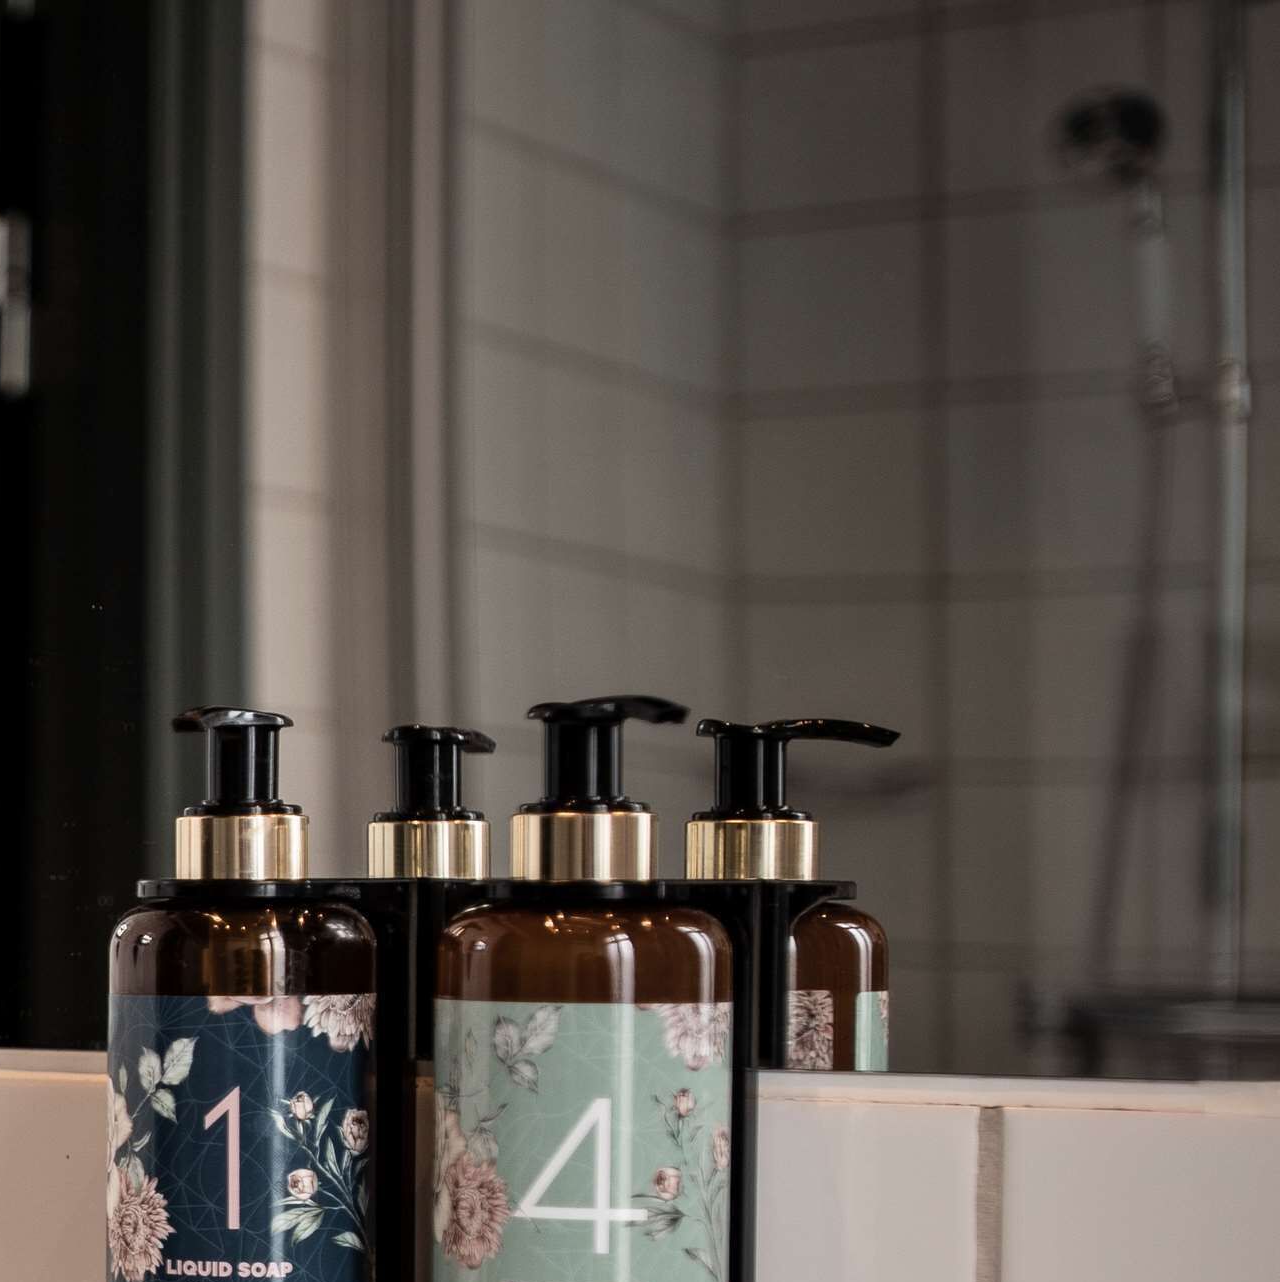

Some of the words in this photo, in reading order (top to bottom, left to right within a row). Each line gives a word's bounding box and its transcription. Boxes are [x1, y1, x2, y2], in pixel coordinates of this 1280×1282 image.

[203, 1085, 241, 1230] 1
[511, 1098, 649, 1254] 4
[166, 1258, 233, 1277] LIQUID
[237, 1261, 294, 1278] SOAP
